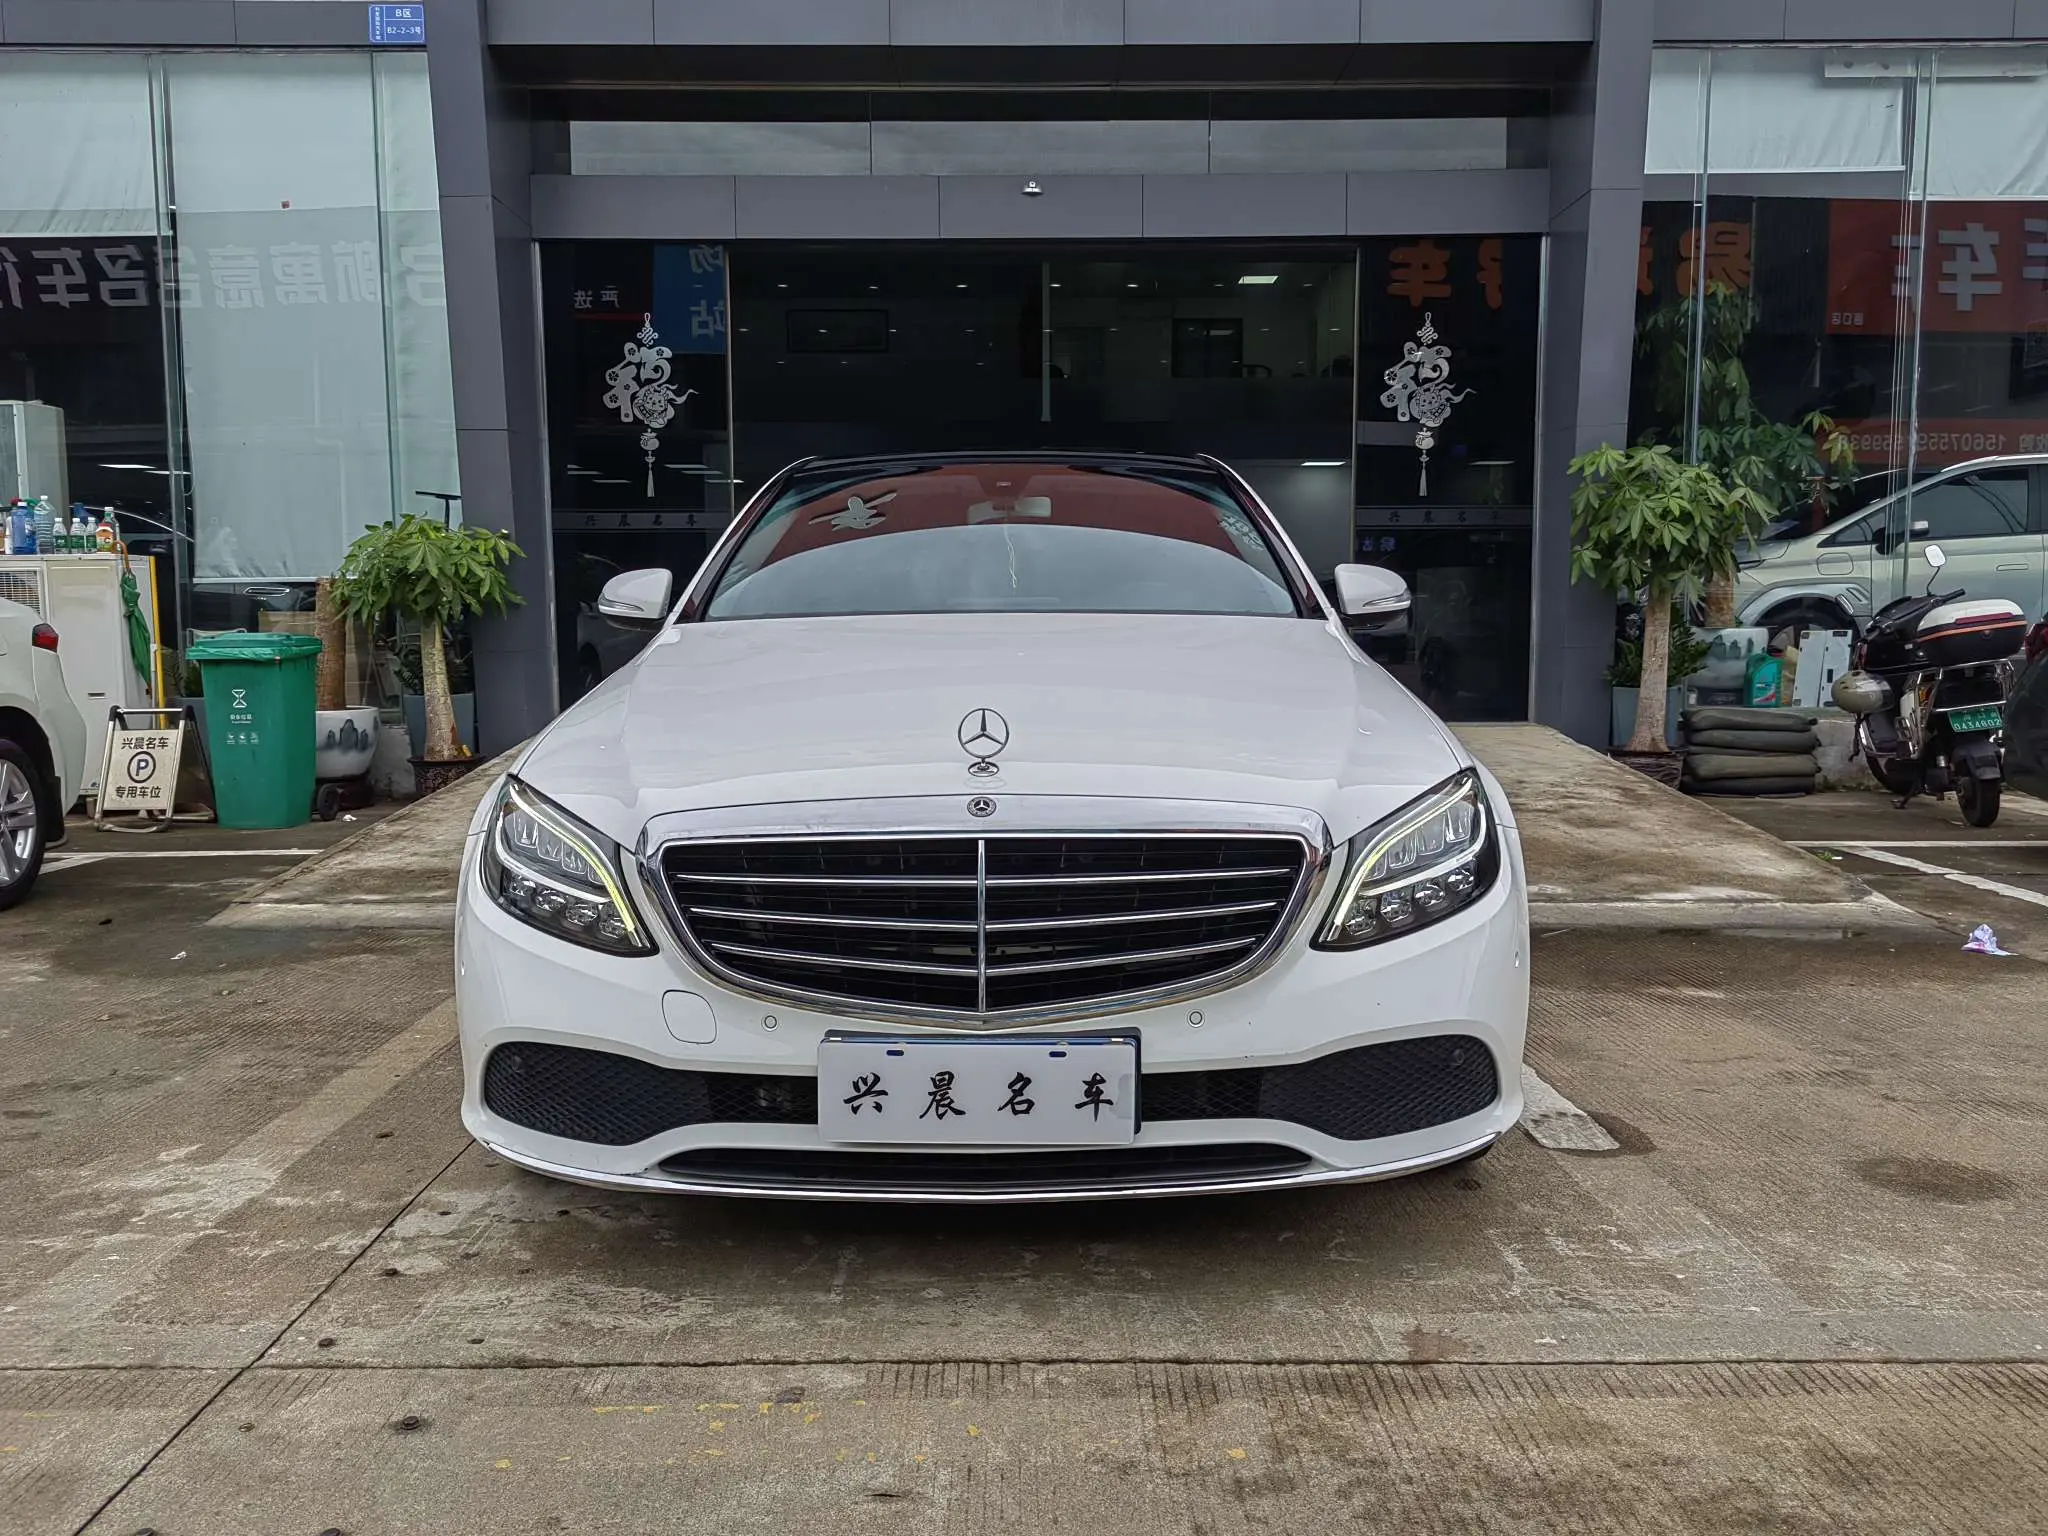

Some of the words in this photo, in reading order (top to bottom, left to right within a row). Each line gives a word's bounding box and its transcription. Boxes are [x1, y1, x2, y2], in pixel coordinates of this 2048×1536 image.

[121, 737, 169, 750] 兴晨名车
[135, 759, 149, 777] P
[115, 786, 161, 799] 专用车位
[843, 1071, 1114, 1122] 兴晨名车
